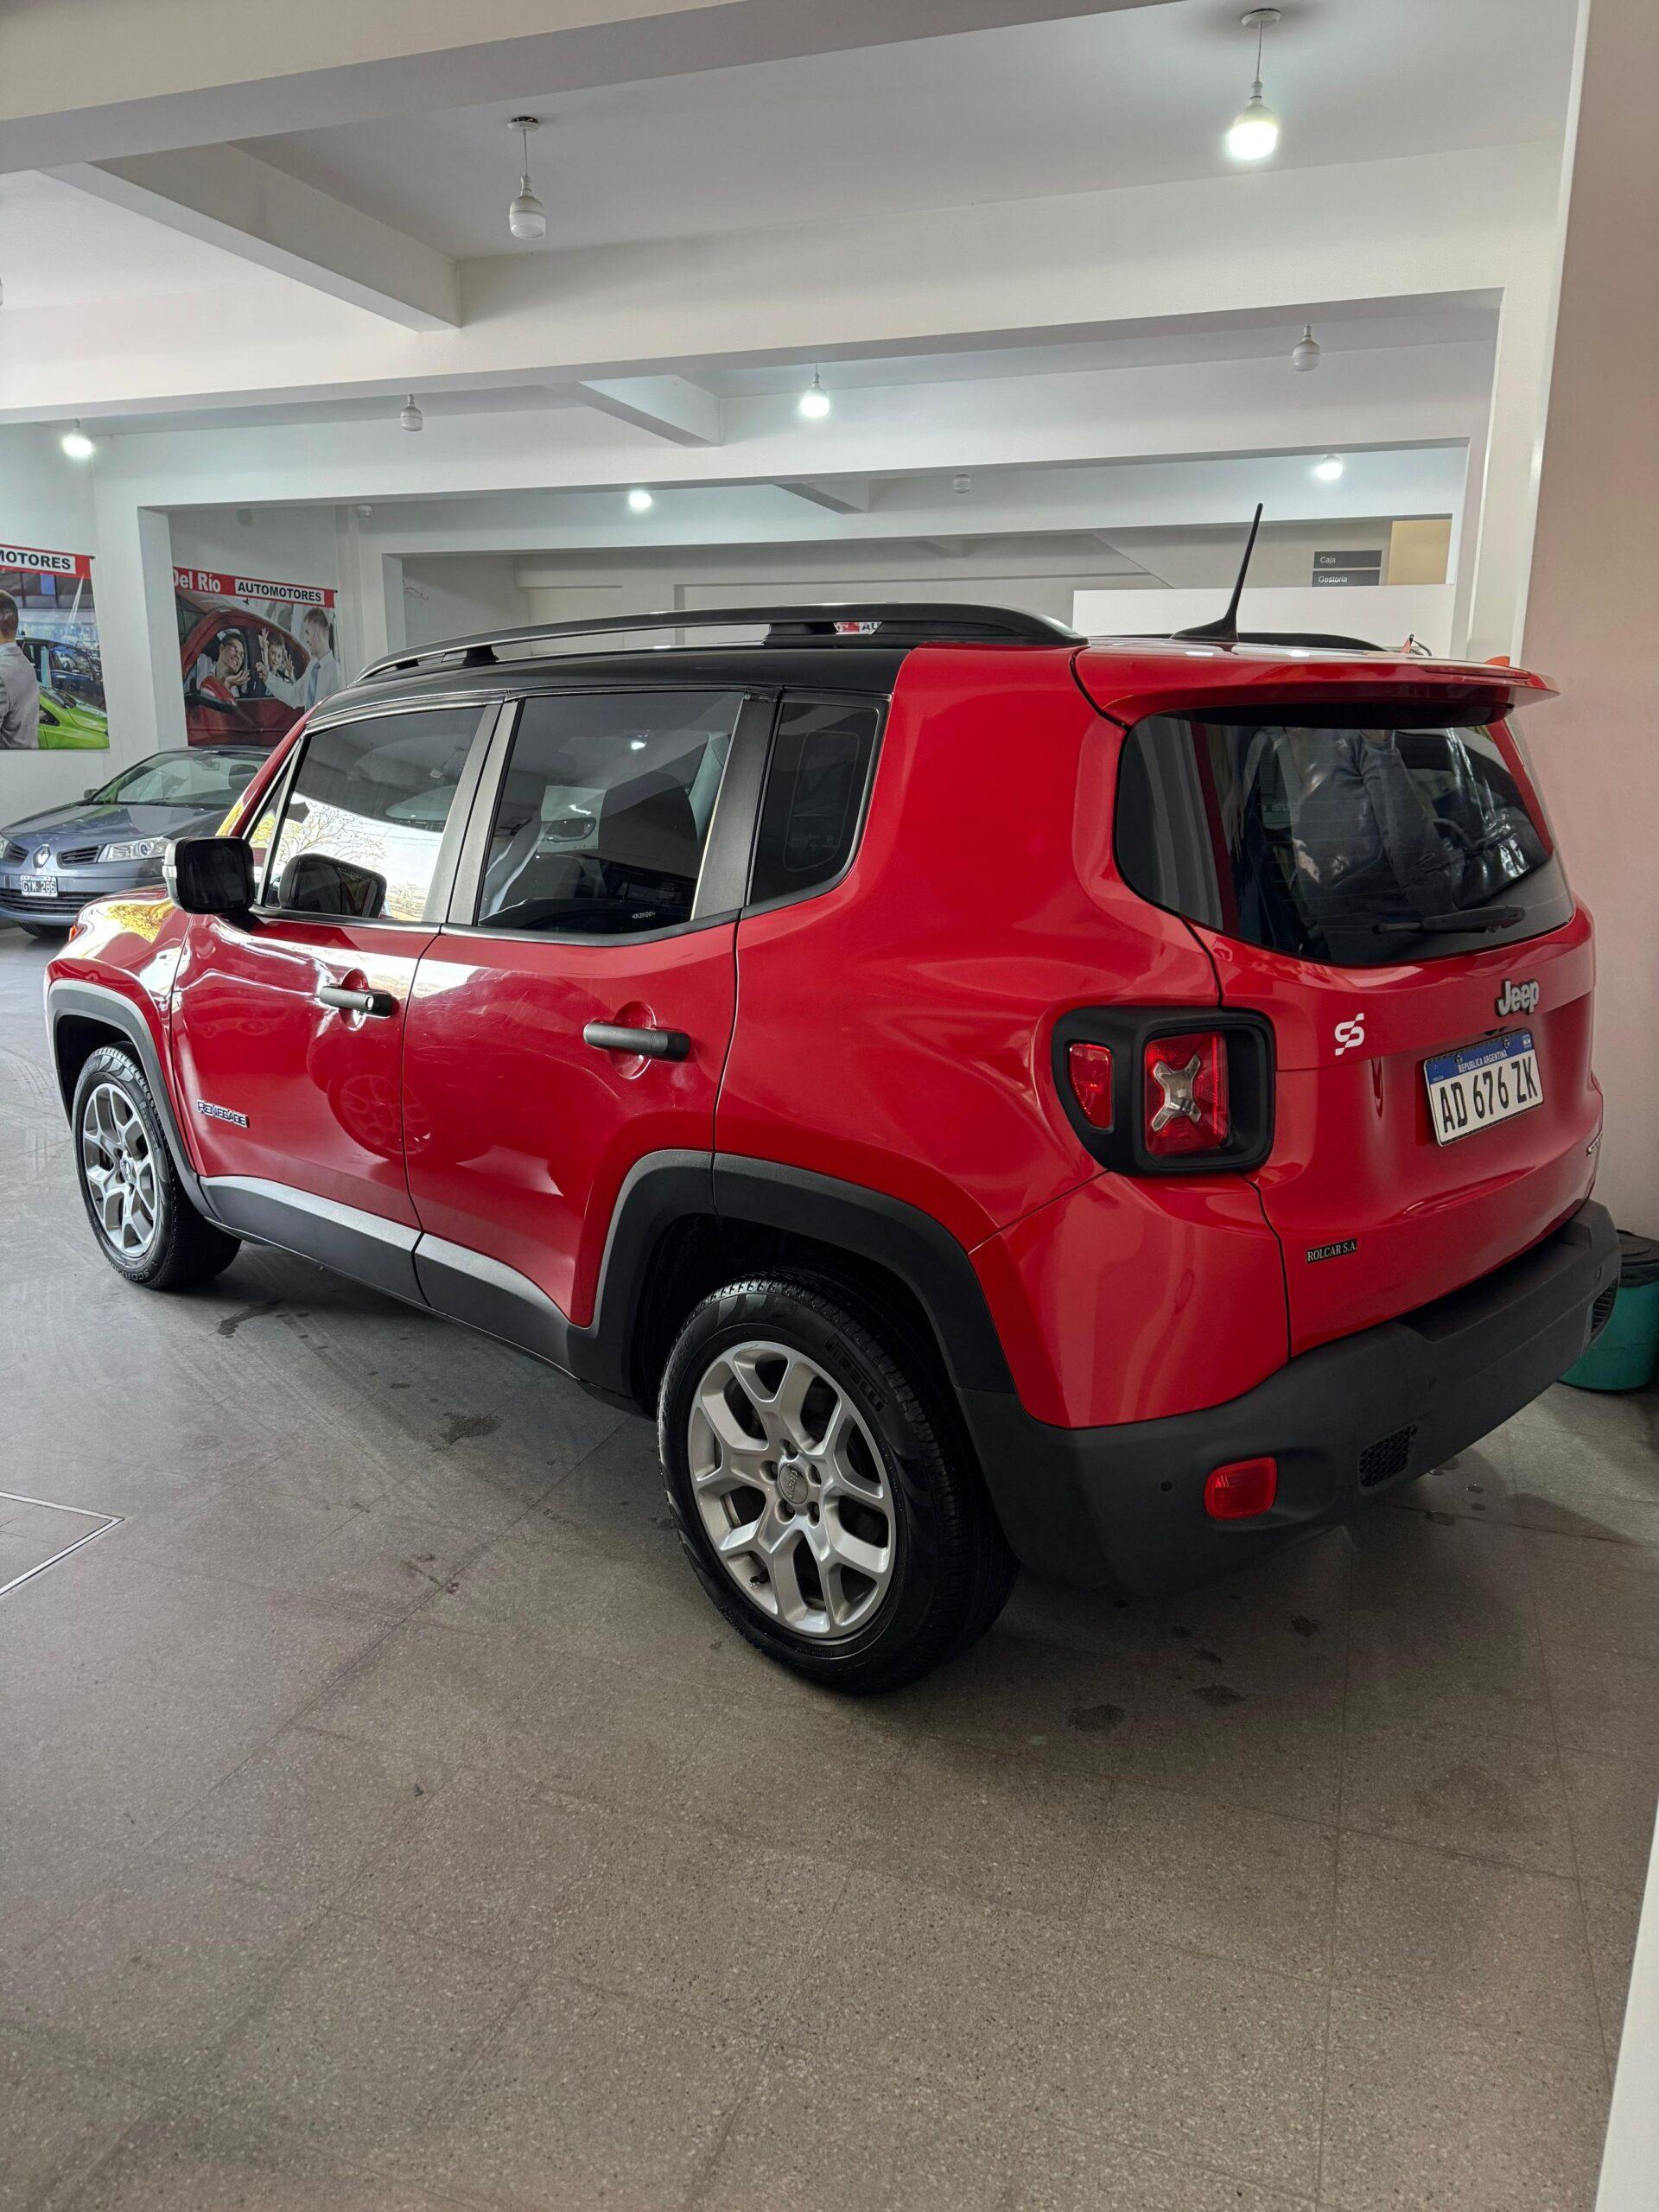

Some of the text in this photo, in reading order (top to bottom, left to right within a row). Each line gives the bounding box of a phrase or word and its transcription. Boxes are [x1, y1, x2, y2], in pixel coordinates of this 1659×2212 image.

[198, 572, 221, 593] Río
[238, 581, 322, 602] AUTOMOTORES
[40, 880, 55, 893] 286
[1496, 979, 1539, 1016] Jeep
[1440, 1056, 1538, 1133] AD 676 ZK
[197, 1099, 248, 1128] RENEGADE
[1307, 1241, 1357, 1262] ROLCAR S.A.
